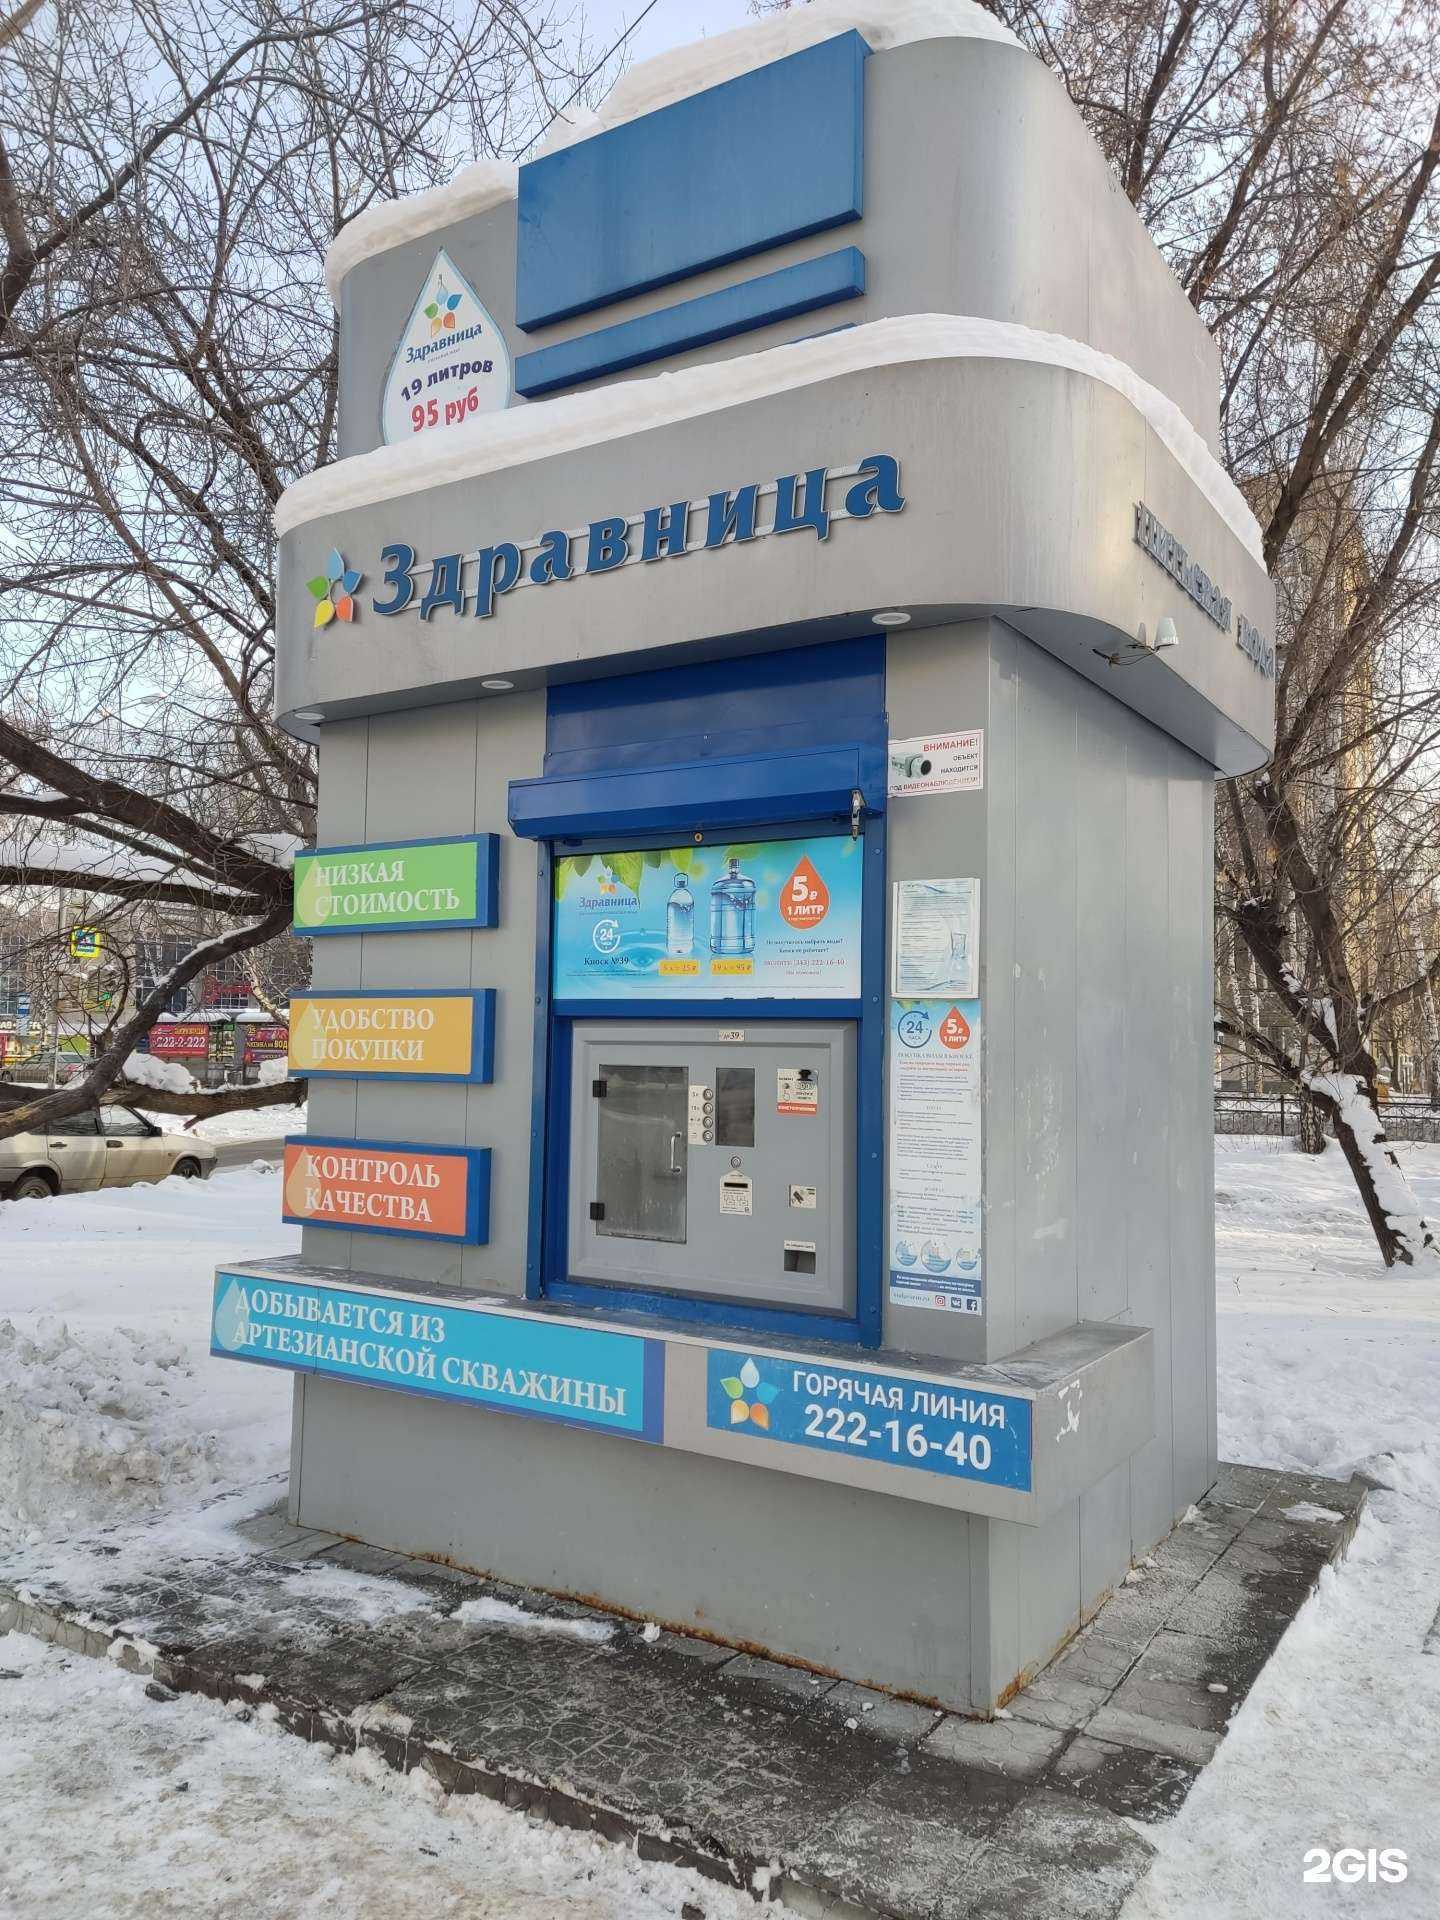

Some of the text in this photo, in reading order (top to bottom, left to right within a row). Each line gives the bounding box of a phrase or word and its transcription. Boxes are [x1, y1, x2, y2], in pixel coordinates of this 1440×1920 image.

[406, 324, 482, 363] Здравница
[401, 359, 494, 401] 19 литров
[411, 386, 479, 431] 95 руб
[373, 453, 906, 620] Здравница
[923, 738, 978, 752] ВНИМАНИЕ!
[953, 753, 978, 761] ОБЪЕКТ
[941, 765, 978, 774] НАХОДИТСЯ
[314, 860, 405, 887] НИЗКАЯ
[315, 887, 460, 917] СТОИМОСТЬ
[579, 896, 638, 910] Здравница
[787, 904, 825, 916] 1 ЛИТР
[600, 928, 613, 941] 24
[584, 956, 629, 966] Киоск №39
[313, 1007, 435, 1034] УДОБСТВО
[907, 1021, 923, 1033] 24
[311, 1037, 425, 1061] ПОКУПКИ
[948, 1035, 967, 1043] ЛИТР
[305, 1154, 440, 1188] КОНТРОЛЬ
[304, 1187, 432, 1223] КАЧЕСТВА
[234, 1287, 446, 1343] ДОБЫВАЕТСЯ ИЗ
[232, 1320, 627, 1417] АРТЕЗИАНСКОЙ СКВАЖИНЫ
[793, 1370, 1005, 1429] ГОРЯЧАЯ ЛИНИЯ
[804, 1403, 992, 1471] 222-16-40
